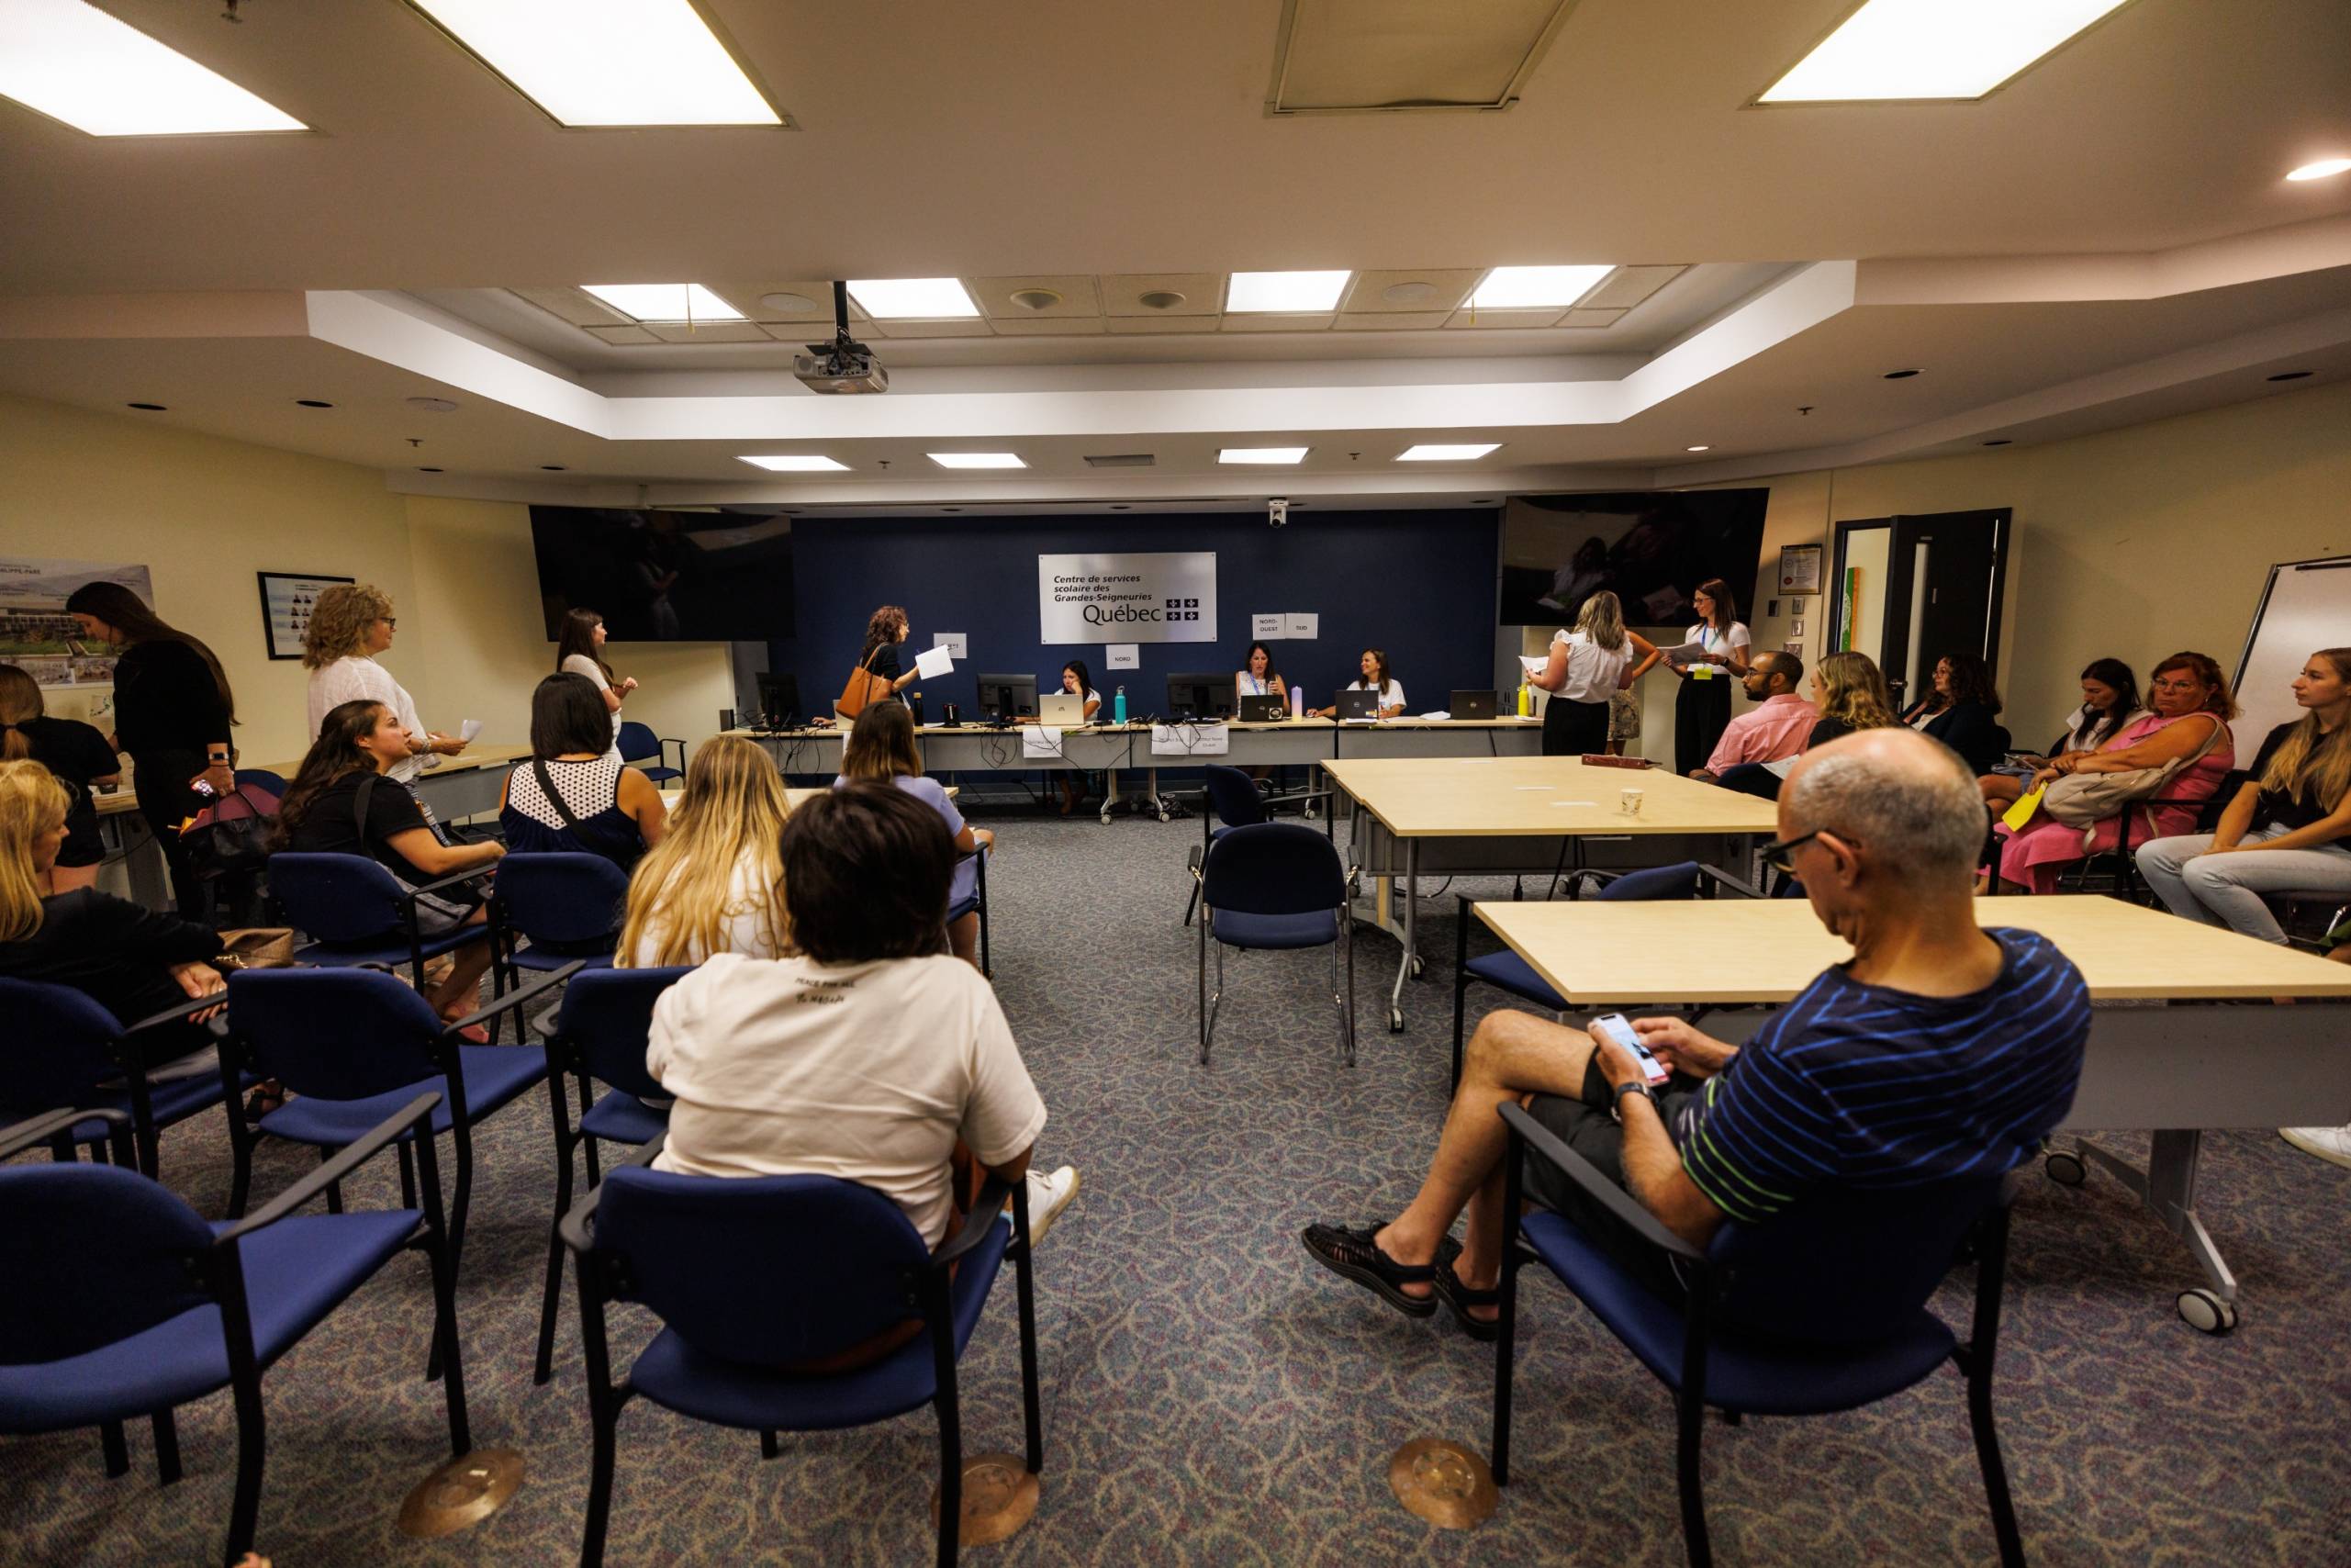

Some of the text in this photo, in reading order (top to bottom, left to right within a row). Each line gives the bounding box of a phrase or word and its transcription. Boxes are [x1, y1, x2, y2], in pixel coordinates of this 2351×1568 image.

[1103, 575, 1141, 583] services
[1054, 585, 1091, 593] scolaire
[1054, 593, 1153, 603] Grandes-Seigneuries
[1083, 604, 1161, 625] Québec
